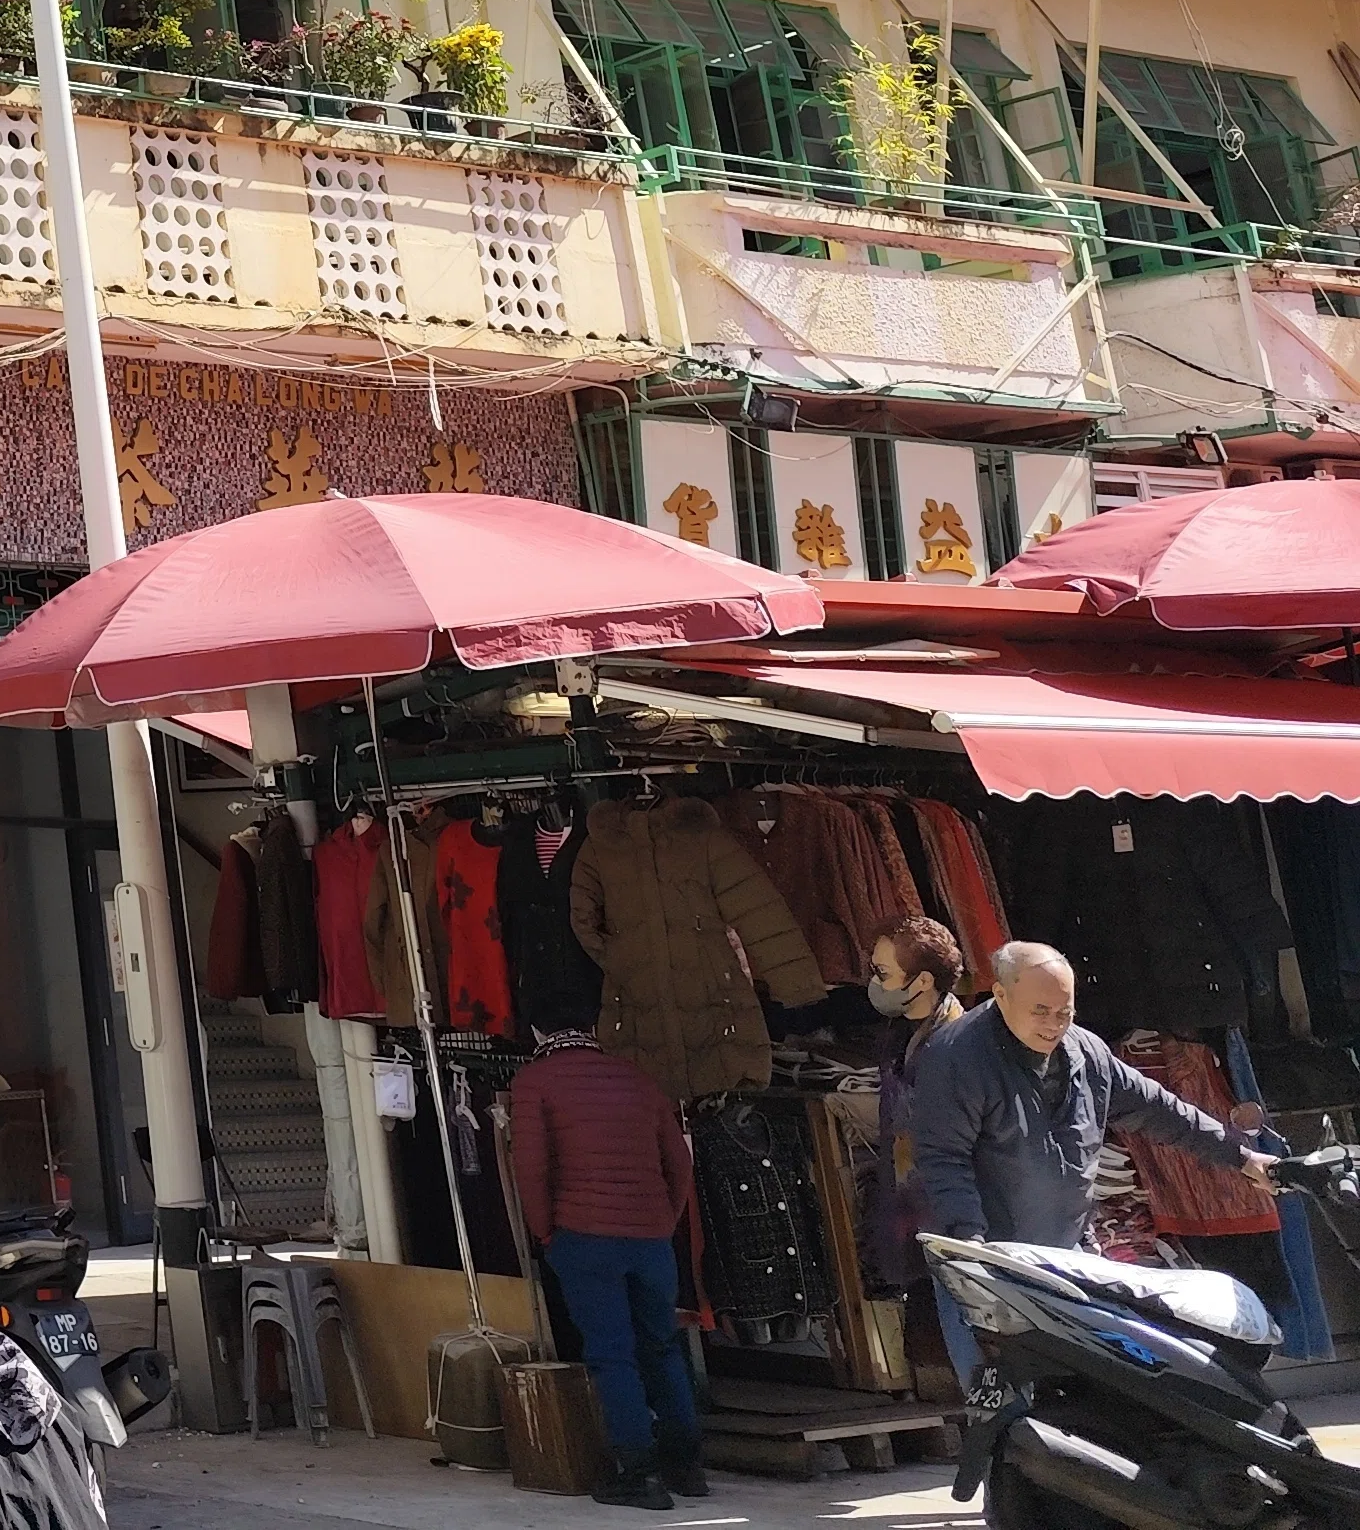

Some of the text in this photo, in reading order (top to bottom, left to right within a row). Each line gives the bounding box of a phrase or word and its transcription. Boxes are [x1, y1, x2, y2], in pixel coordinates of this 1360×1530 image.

[126, 364, 168, 396] DE
[180, 370, 242, 404] CHA
[255, 375, 342, 412] LONG
[353, 386, 392, 416] WA
[54, 1314, 77, 1332] MP
[49, 1333, 99, 1354] 87-16
